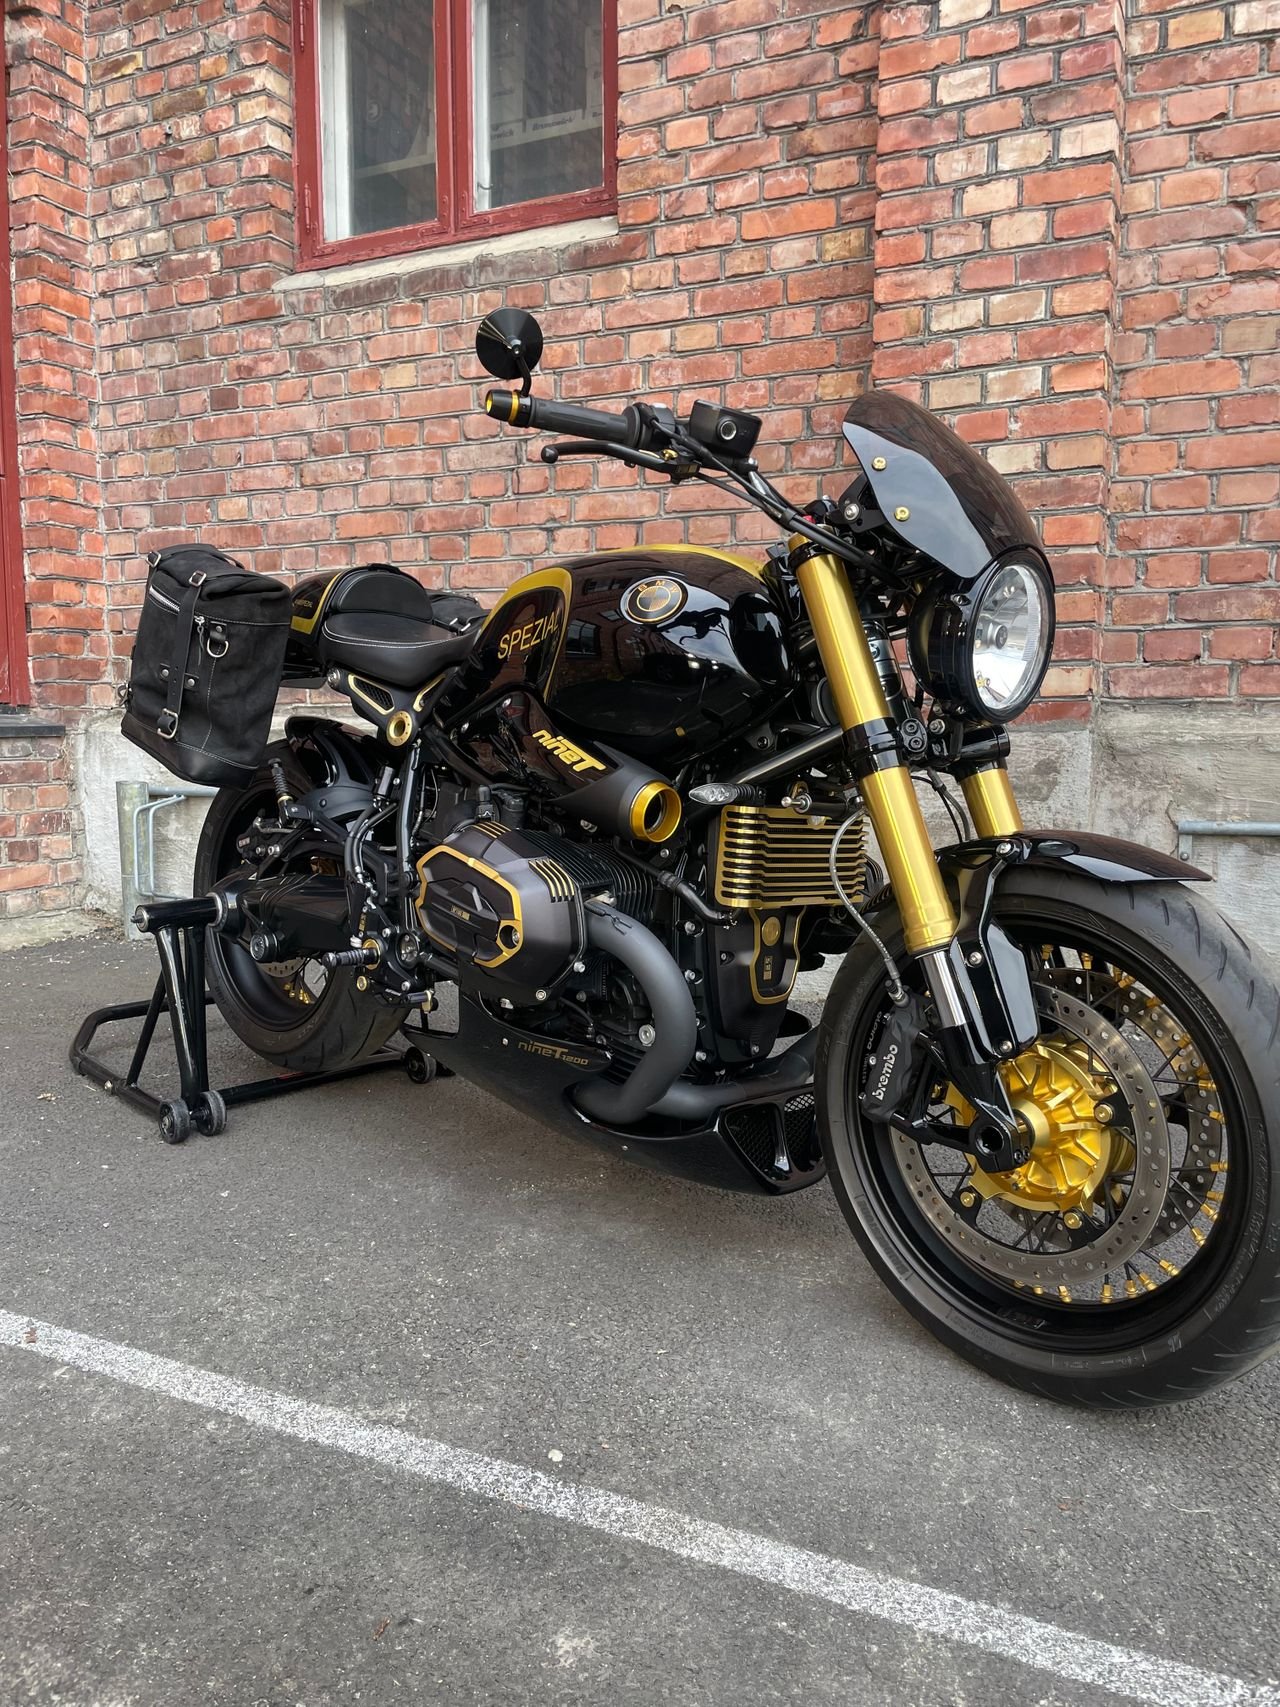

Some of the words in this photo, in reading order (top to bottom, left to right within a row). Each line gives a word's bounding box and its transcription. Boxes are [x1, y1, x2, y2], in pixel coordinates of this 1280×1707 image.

[497, 608, 560, 659] SPEZIAL
[531, 729, 606, 773] nineT
[871, 1044, 899, 1101] brembo
